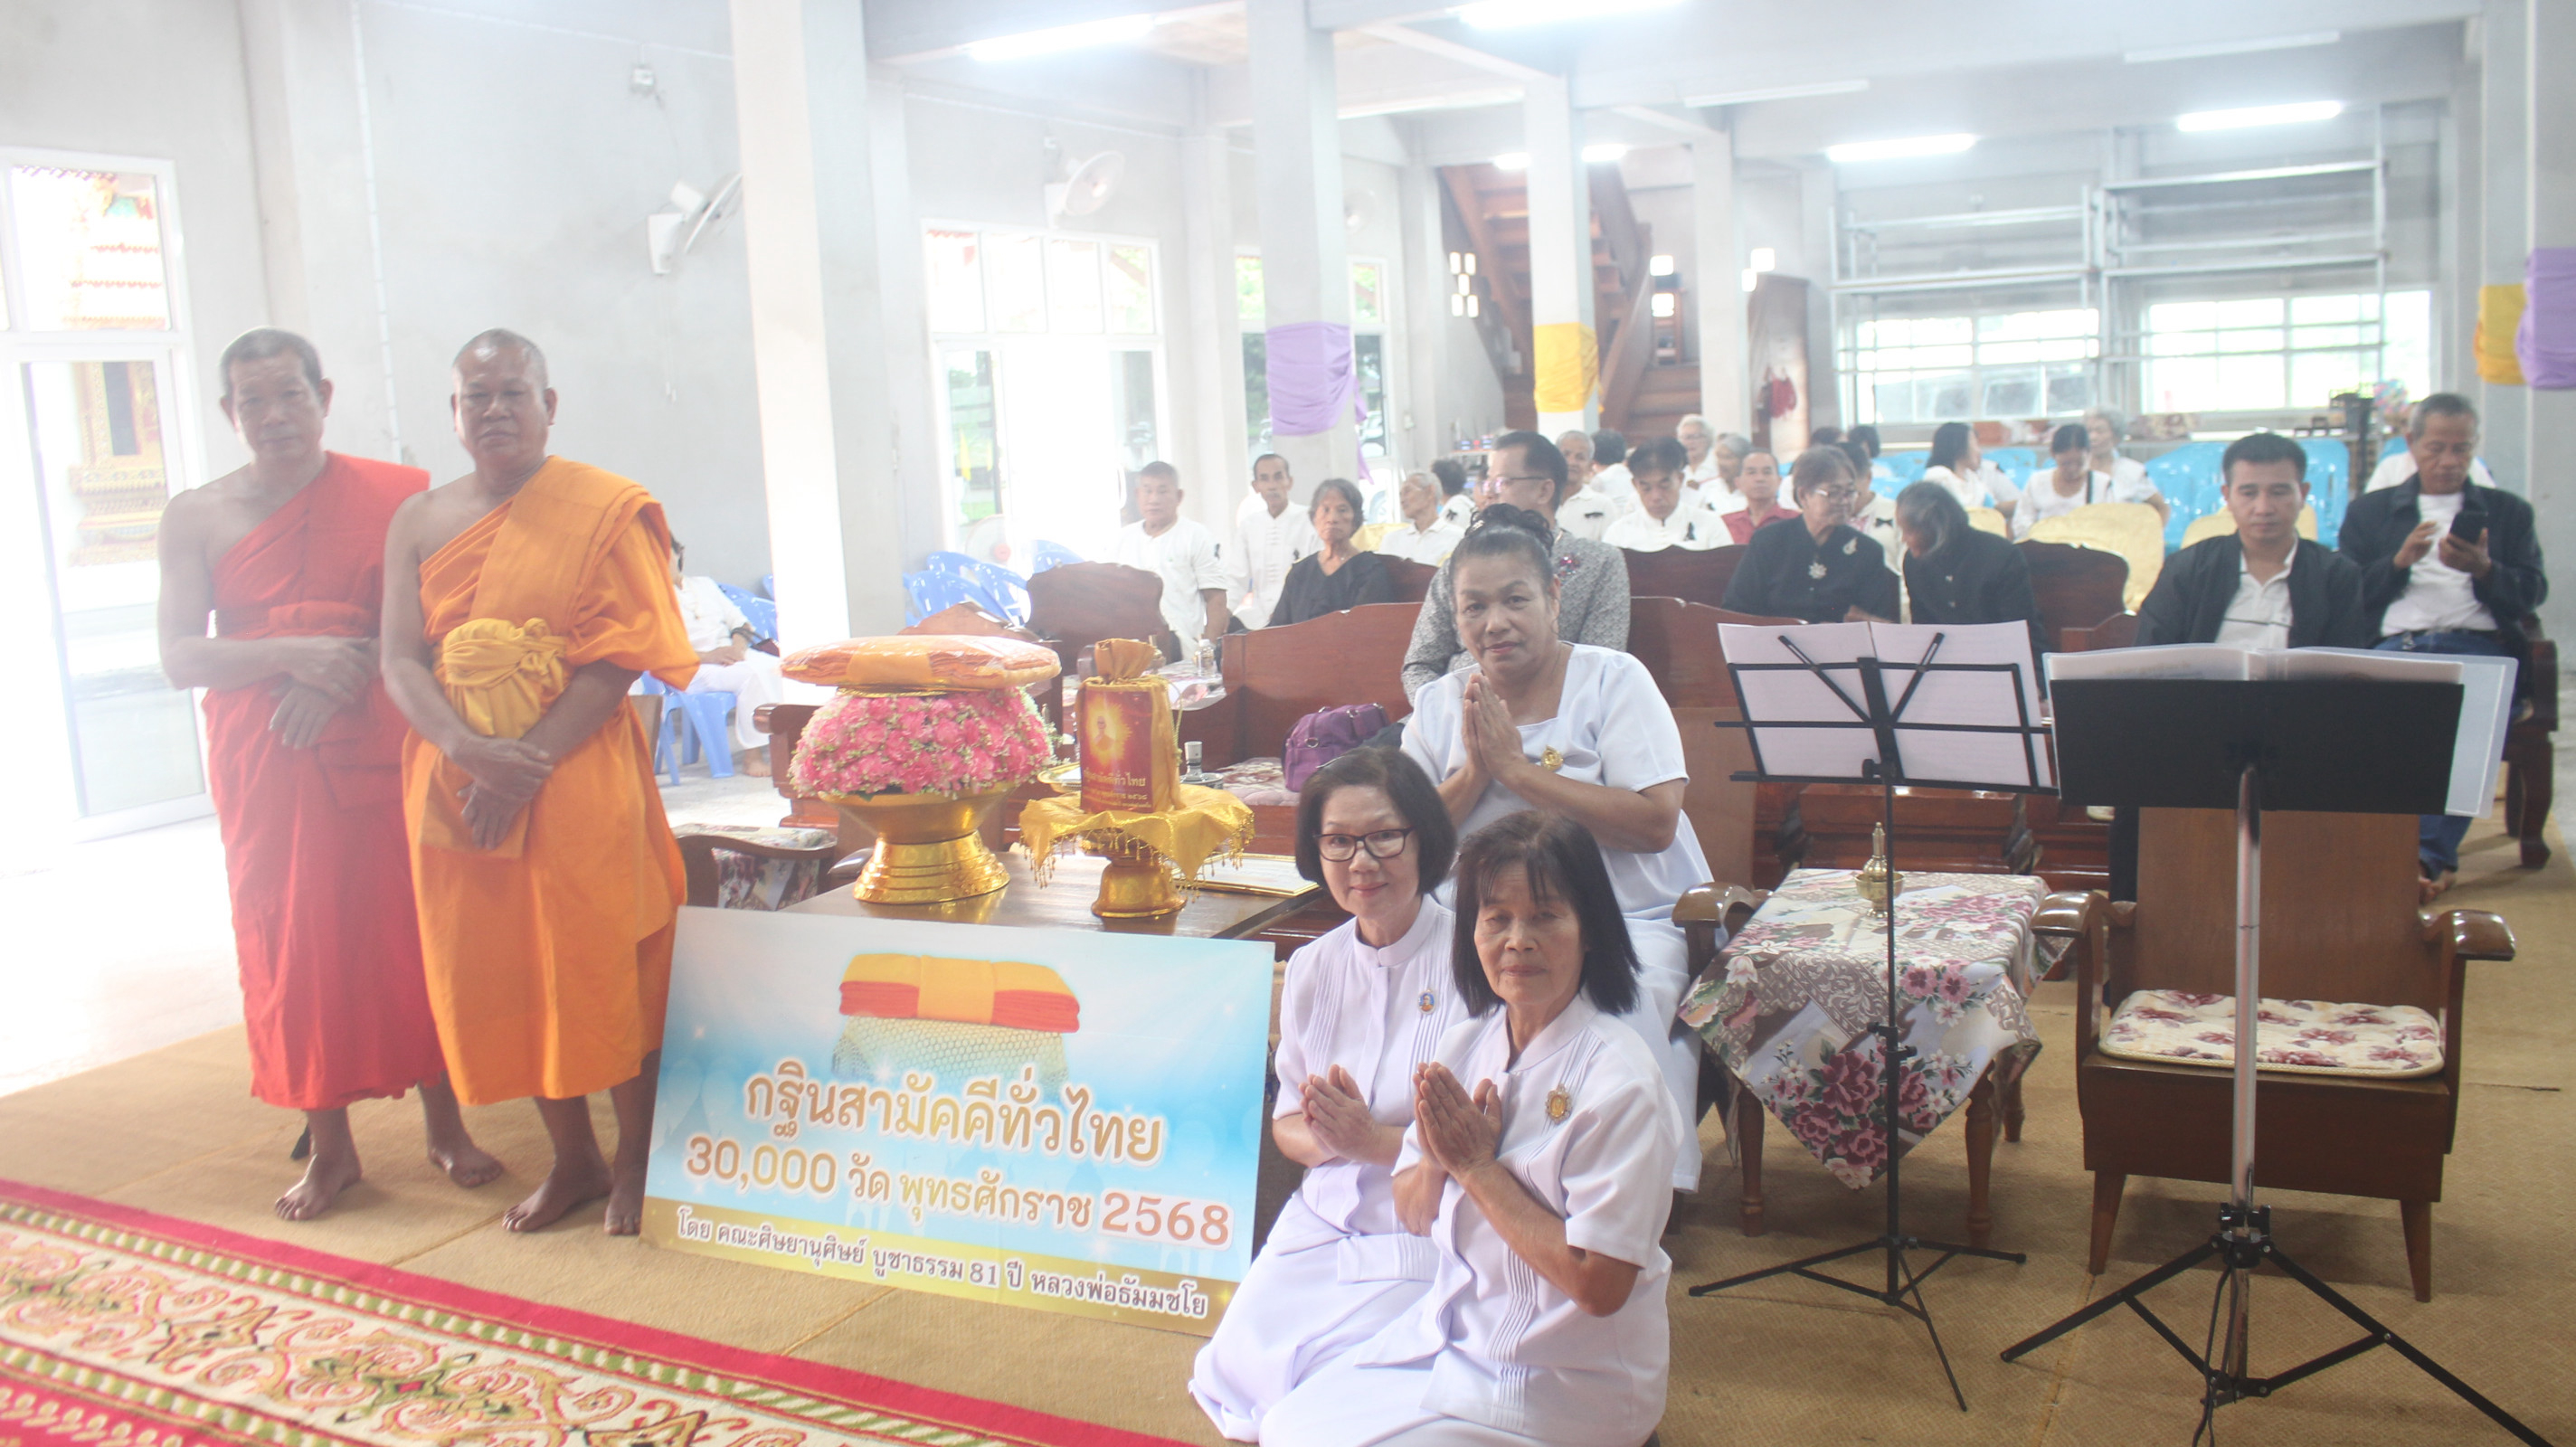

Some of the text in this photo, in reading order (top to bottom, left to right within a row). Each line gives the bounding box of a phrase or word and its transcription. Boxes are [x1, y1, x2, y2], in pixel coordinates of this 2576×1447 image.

[747, 1060, 1161, 1162] กฐินสามัคคีทั่วไทย
[687, 1136, 1229, 1246] 30,000 วัด พุทธศักราช 2568
[679, 1208, 1207, 1316] โดย คณะศิษยานุศิษย์ บูชาธรรม 81 ปี หลวงพ่อธัมมชโย
